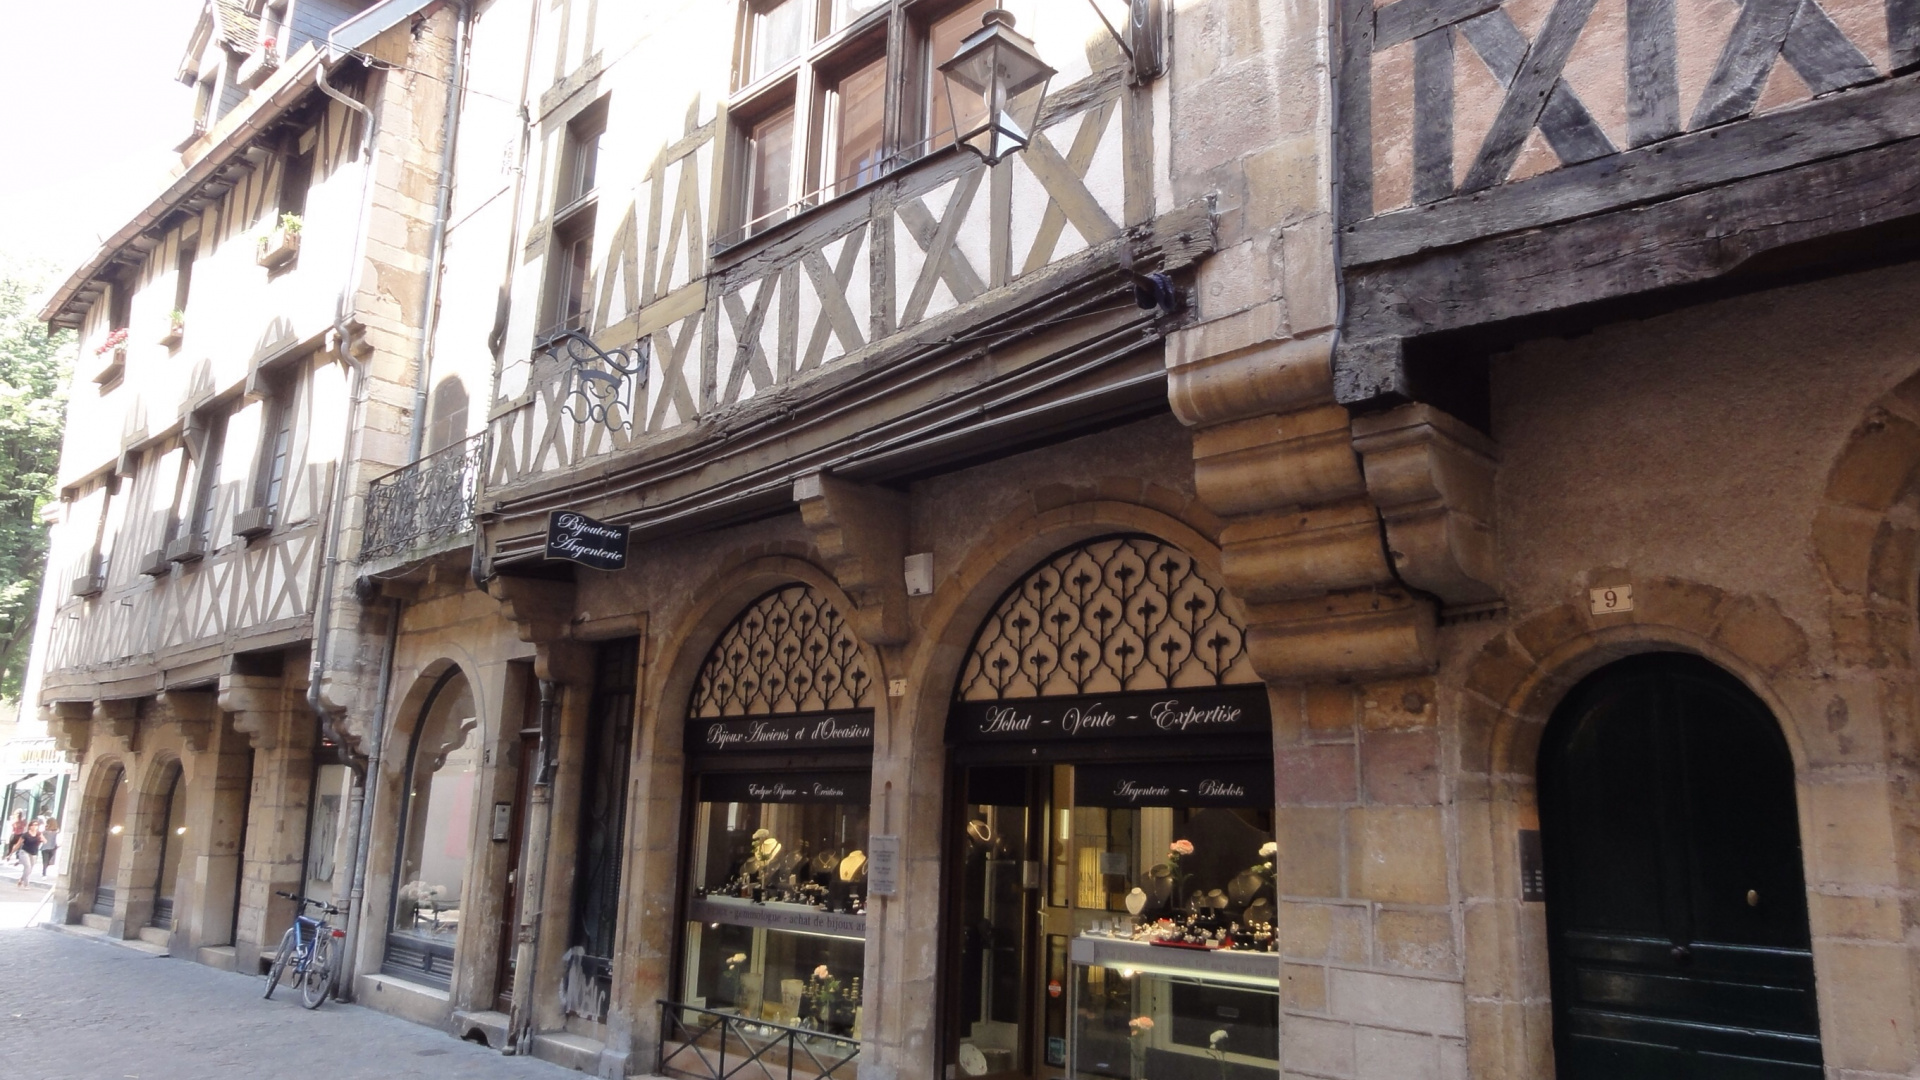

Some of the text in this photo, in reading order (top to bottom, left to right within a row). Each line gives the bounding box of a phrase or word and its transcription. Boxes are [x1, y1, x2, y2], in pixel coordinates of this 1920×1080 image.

[557, 513, 622, 539] Bijouterie
[550, 533, 623, 560] Argenterie
[1604, 590, 1618, 608] 9
[894, 681, 901, 695] 7
[979, 705, 1032, 733] Achat
[1062, 702, 1116, 735] Vente
[1149, 700, 1242, 731] Expertise
[706, 717, 871, 750] Bijoux Anciens et d'Occasion
[1113, 779, 1170, 801] Argenterie
[1198, 778, 1245, 797] Bibelots
[789, 913, 811, 926] achat
[813, 915, 824, 928] de
[827, 916, 853, 931] bijoux
